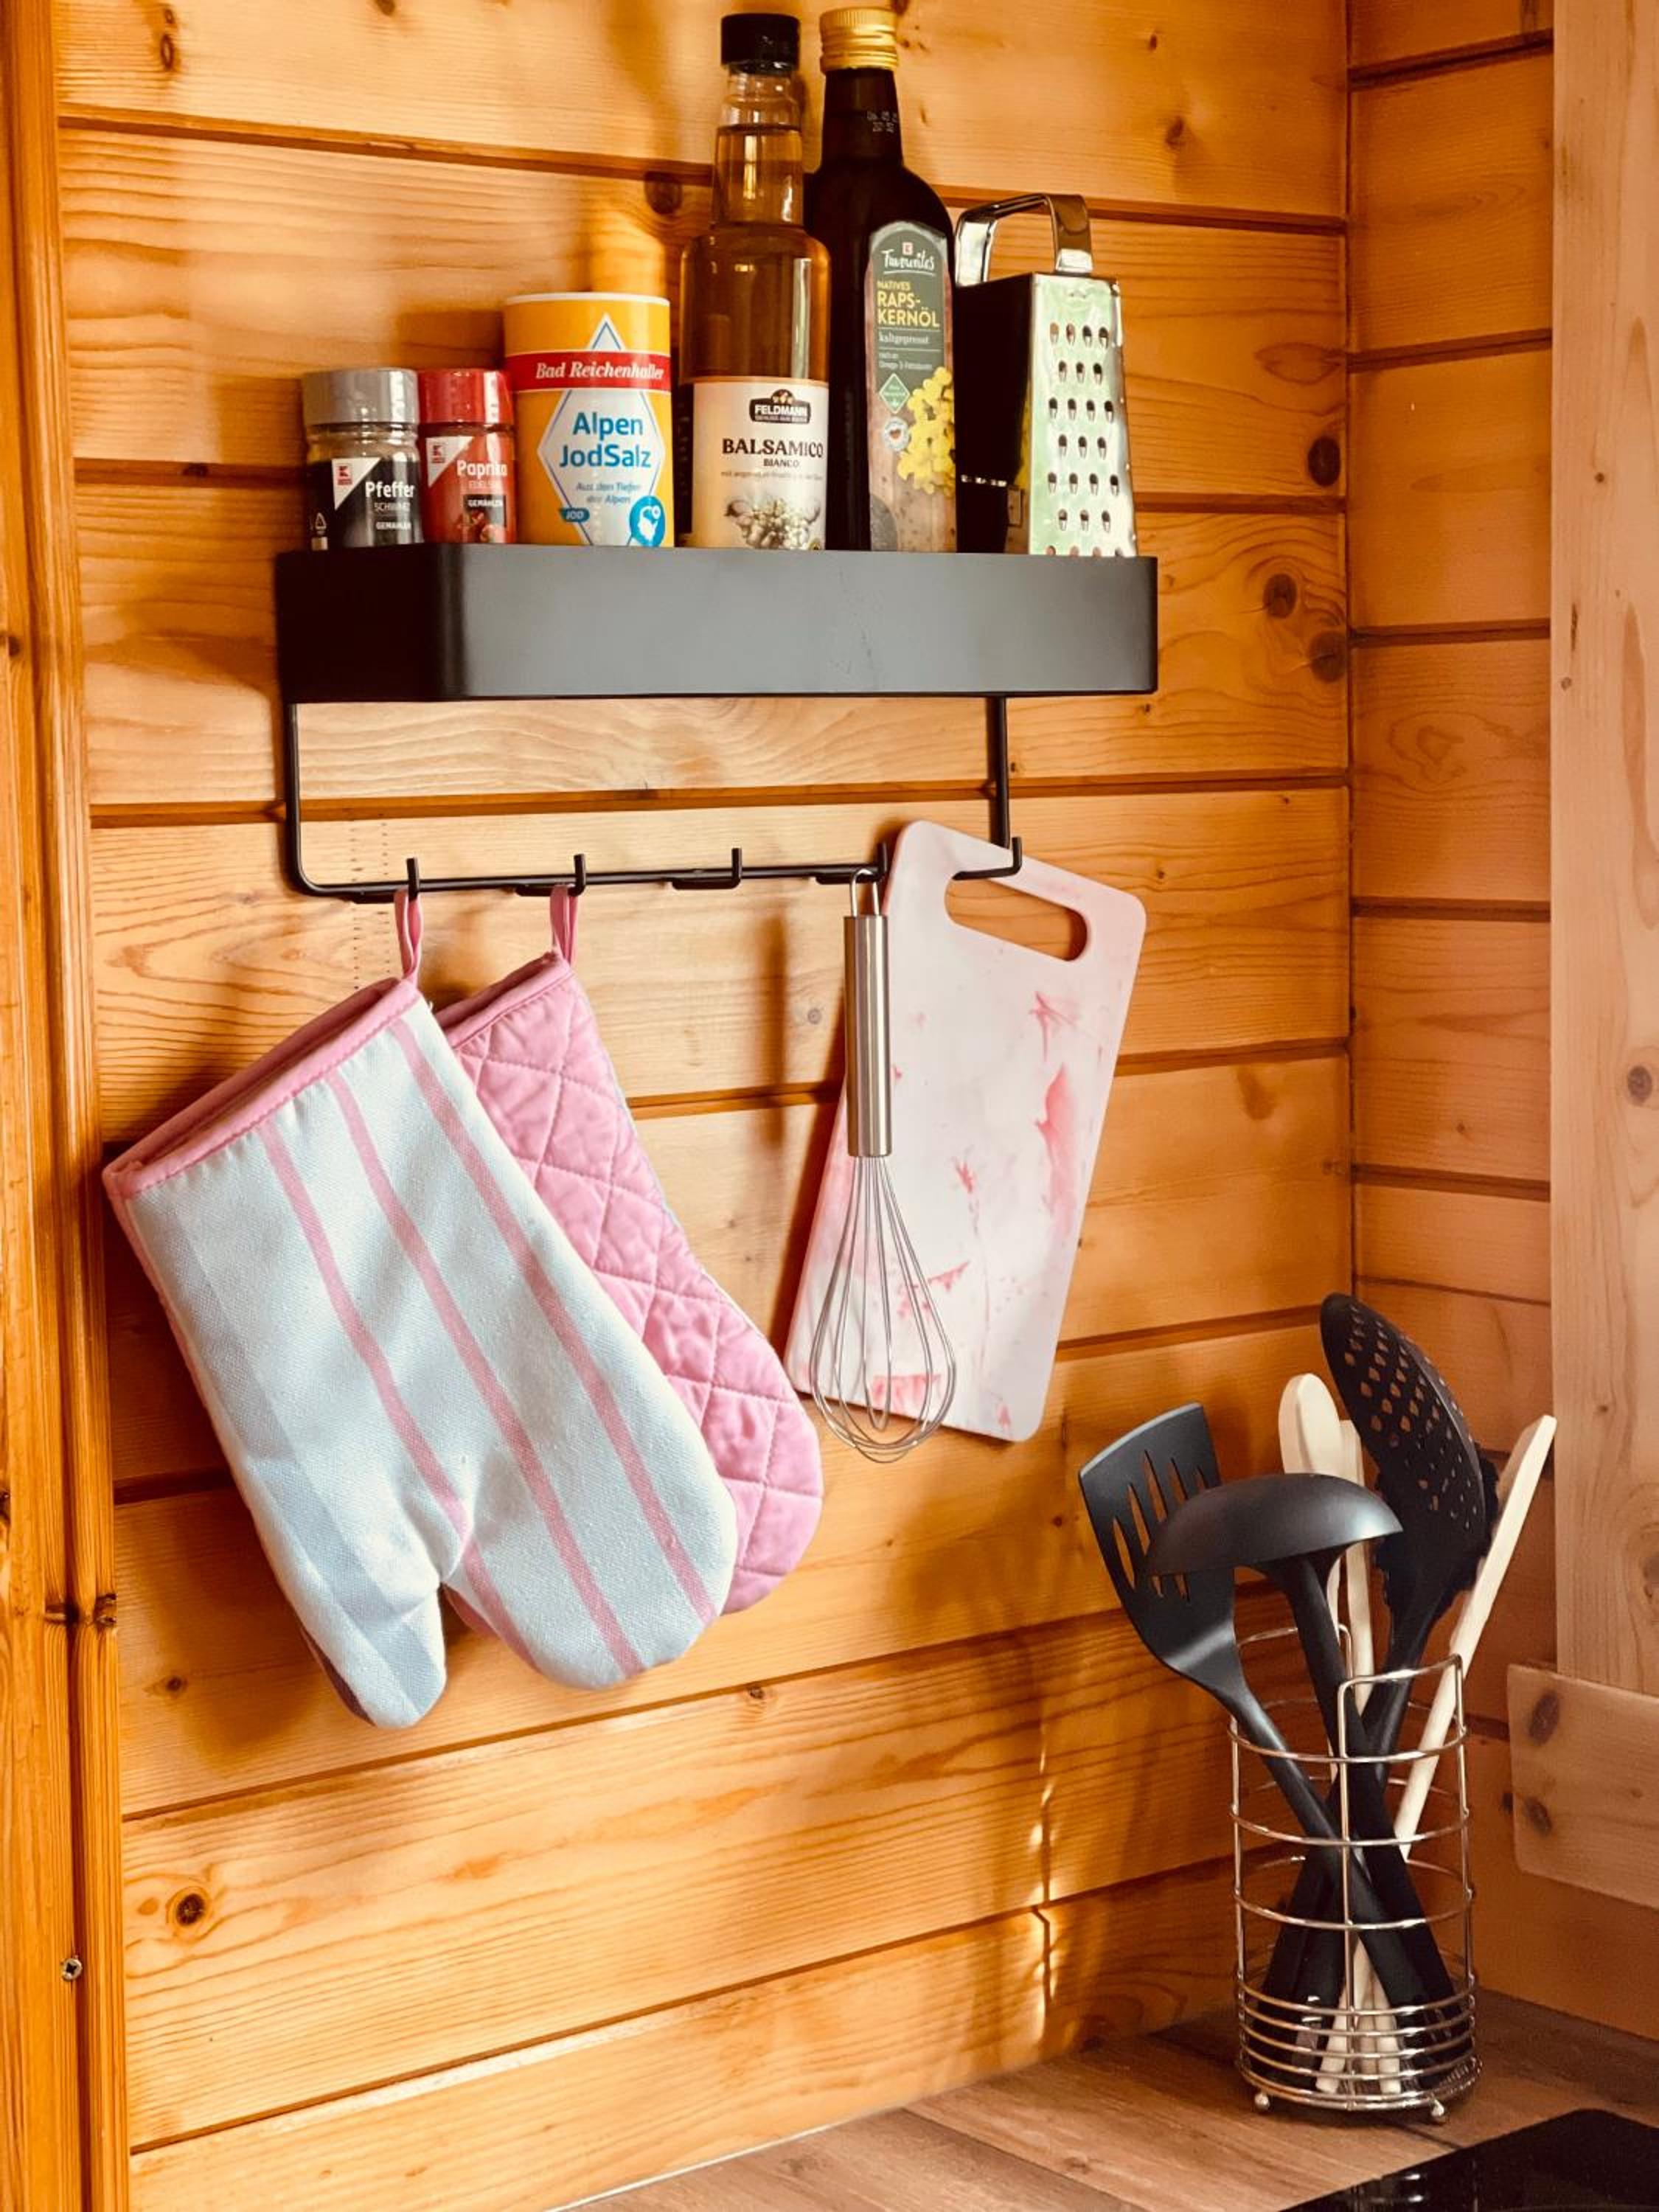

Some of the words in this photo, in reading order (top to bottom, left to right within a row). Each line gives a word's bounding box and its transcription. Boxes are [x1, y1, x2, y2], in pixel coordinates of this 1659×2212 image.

[877, 291, 921, 308] RAPS-
[877, 307, 940, 327] KERNÖL
[535, 362, 567, 379] Bad
[568, 361, 664, 380] Reichenhaller
[754, 404, 808, 417] FELDMANN
[572, 412, 644, 442] Alpen
[560, 444, 652, 468] JodSalz
[722, 438, 824, 458] BALSAMICO
[456, 459, 508, 479] Paprika
[763, 458, 801, 468] BIANCO
[364, 481, 416, 498] Pfeffer
